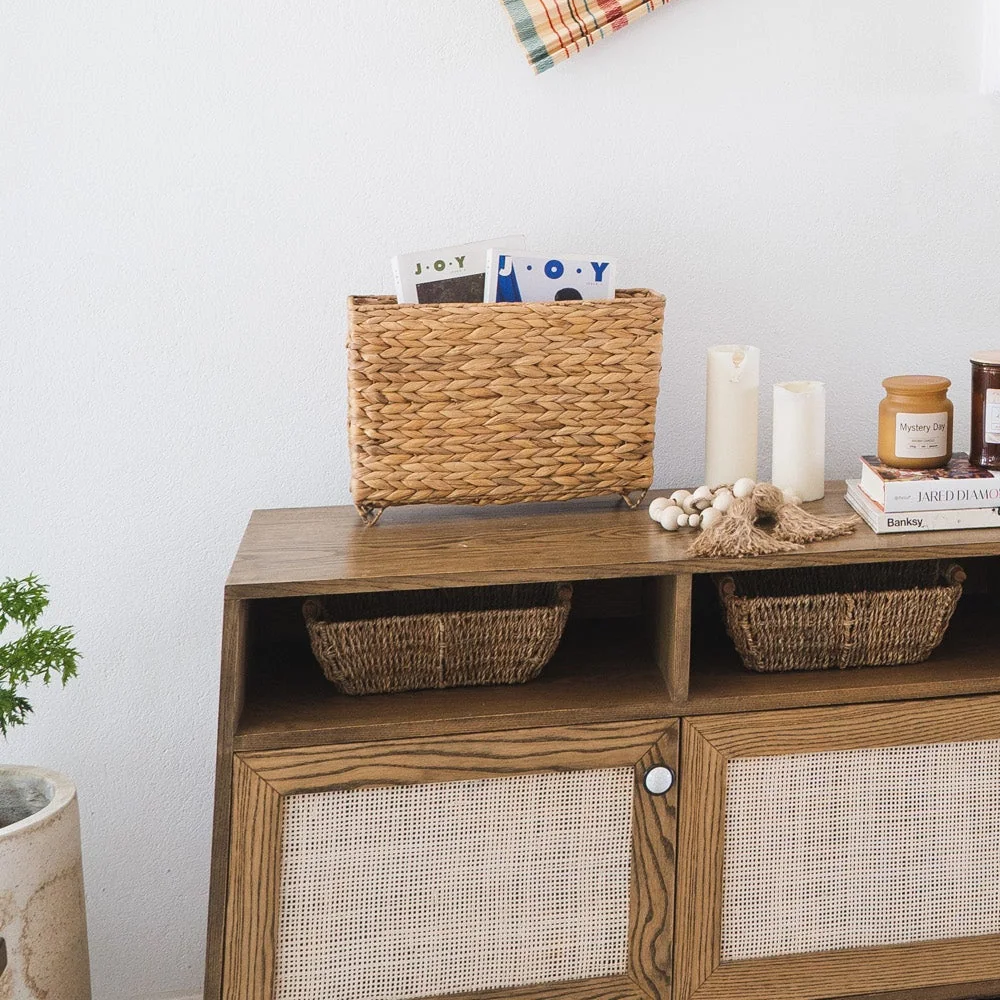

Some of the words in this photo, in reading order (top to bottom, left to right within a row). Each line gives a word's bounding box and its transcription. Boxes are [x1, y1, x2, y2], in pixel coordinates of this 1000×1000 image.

[900, 423, 931, 433] Mystery
[933, 422, 946, 432] Day
[918, 489, 955, 502] JARED
[887, 517, 923, 528] Banksy
